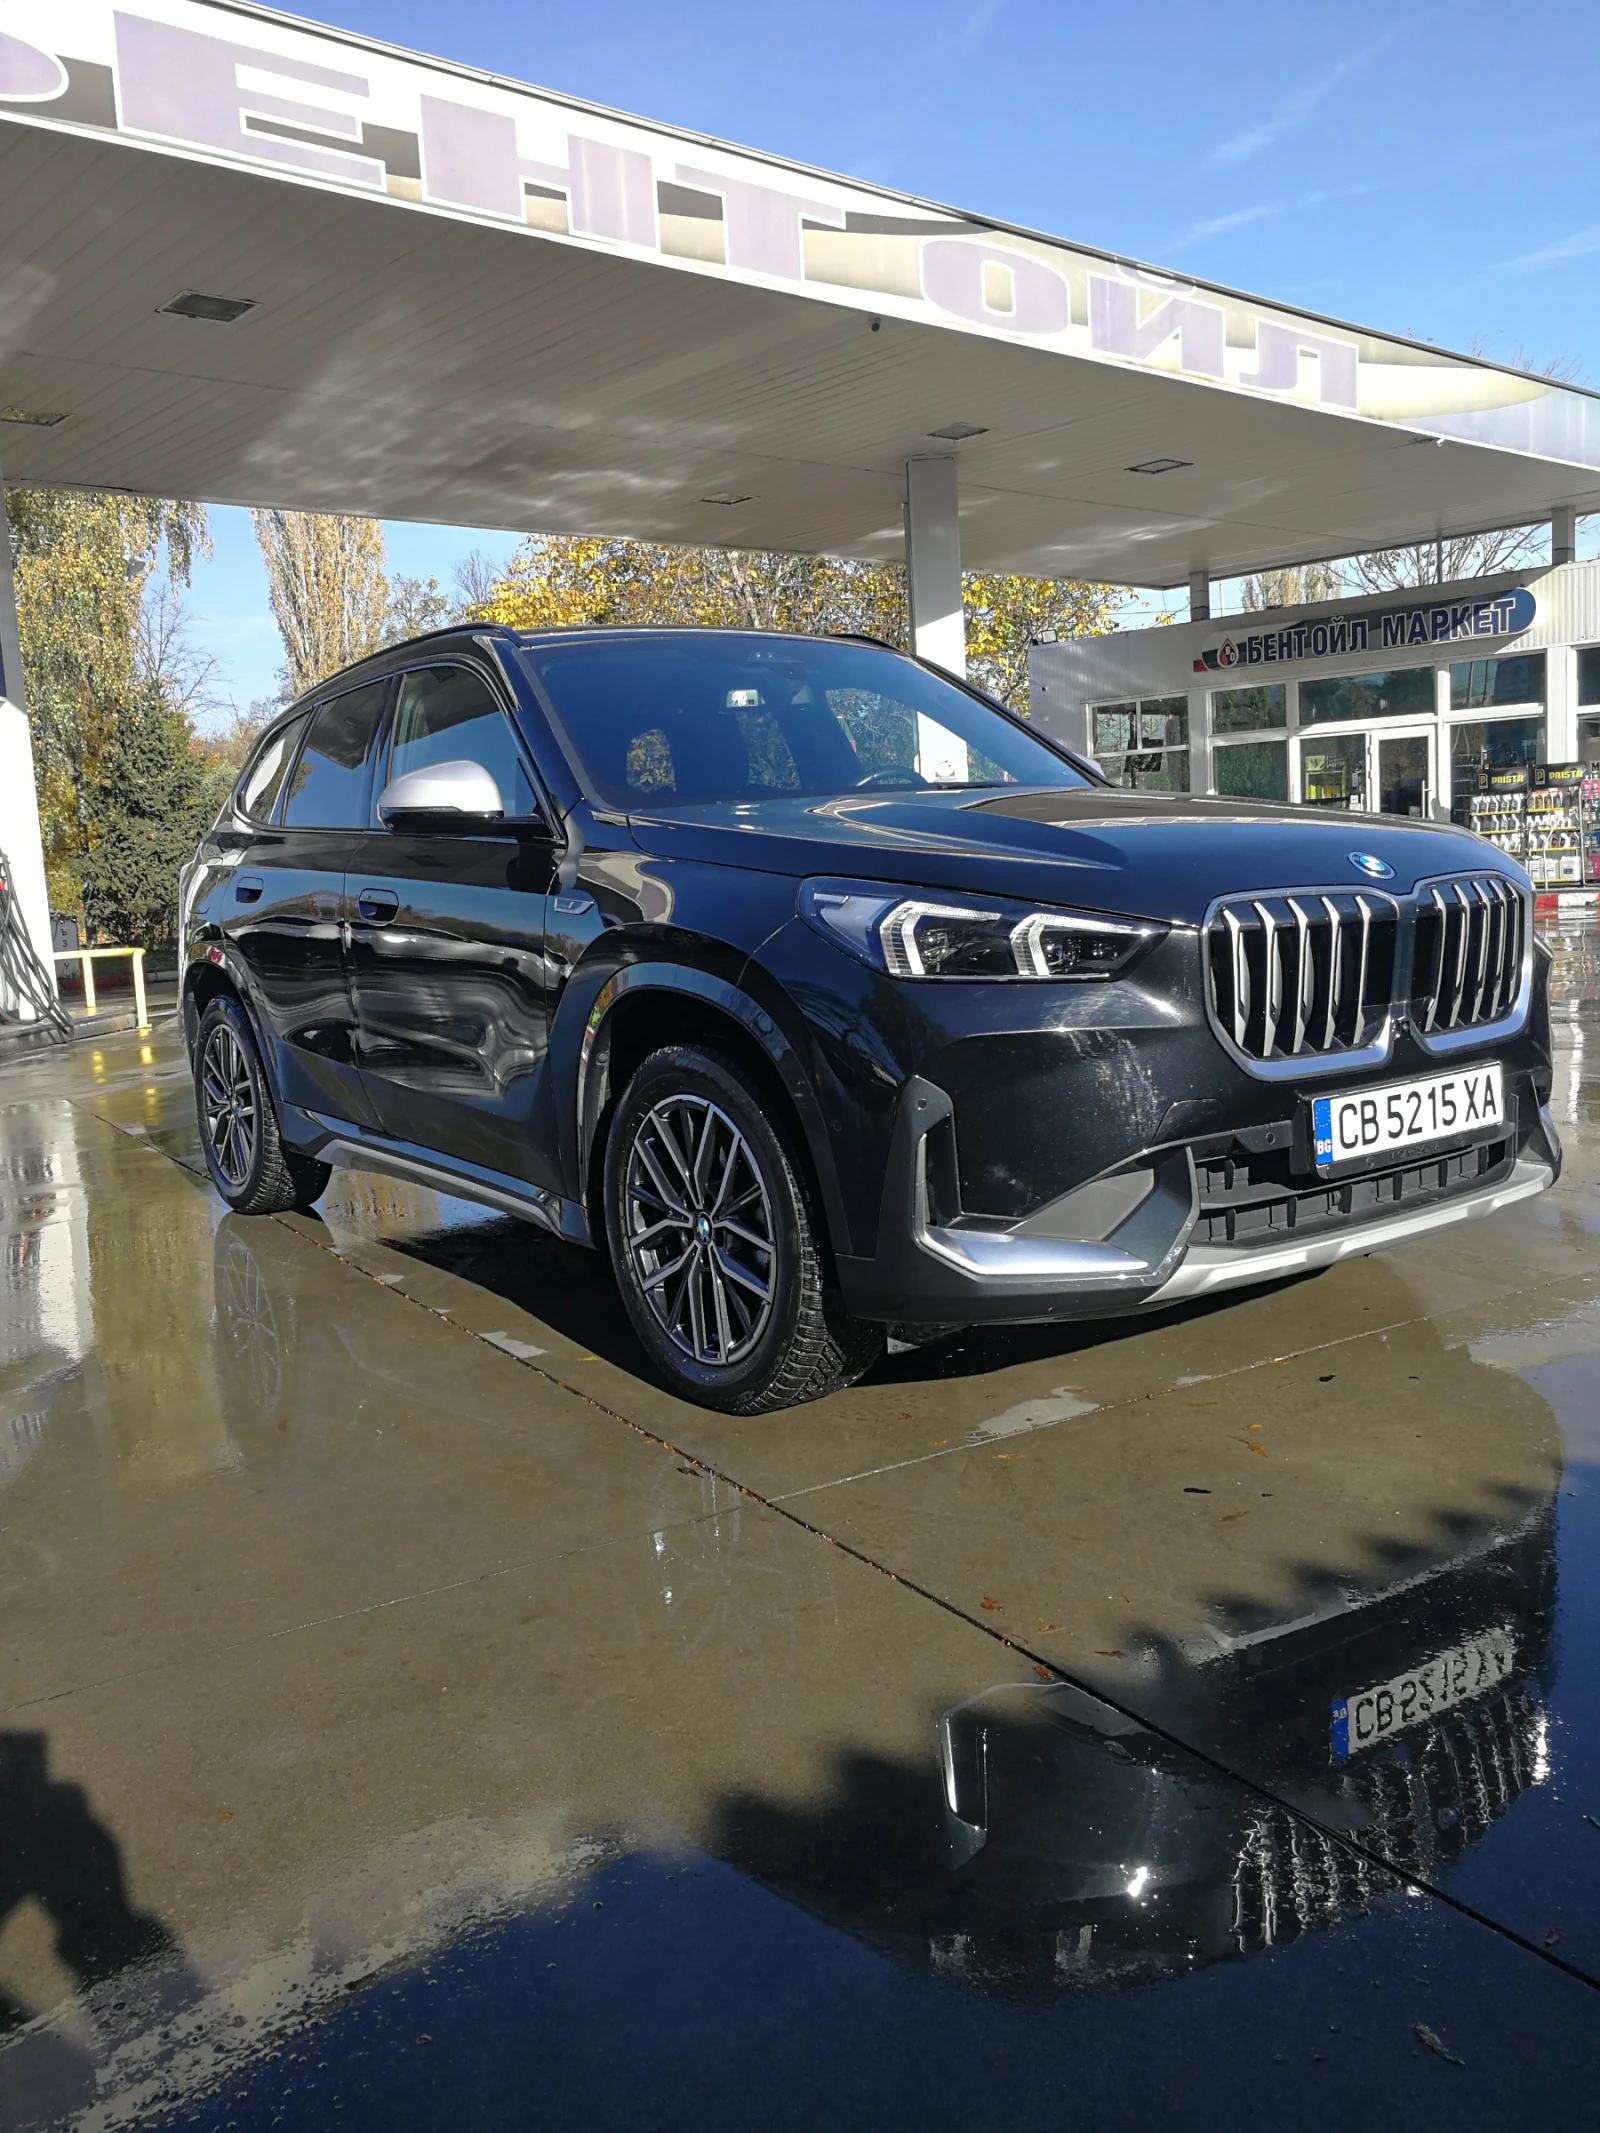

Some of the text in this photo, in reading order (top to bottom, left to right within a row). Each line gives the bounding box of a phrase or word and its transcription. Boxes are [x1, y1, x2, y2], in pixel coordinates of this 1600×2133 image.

[1381, 597, 1516, 648] МАРКЕТ
[1491, 774, 1524, 784] PRISTA
[1549, 770, 1583, 780] PRISTA
[1339, 1074, 1497, 1150] CB 5215 XA
[1316, 1140, 1333, 1155] BG
